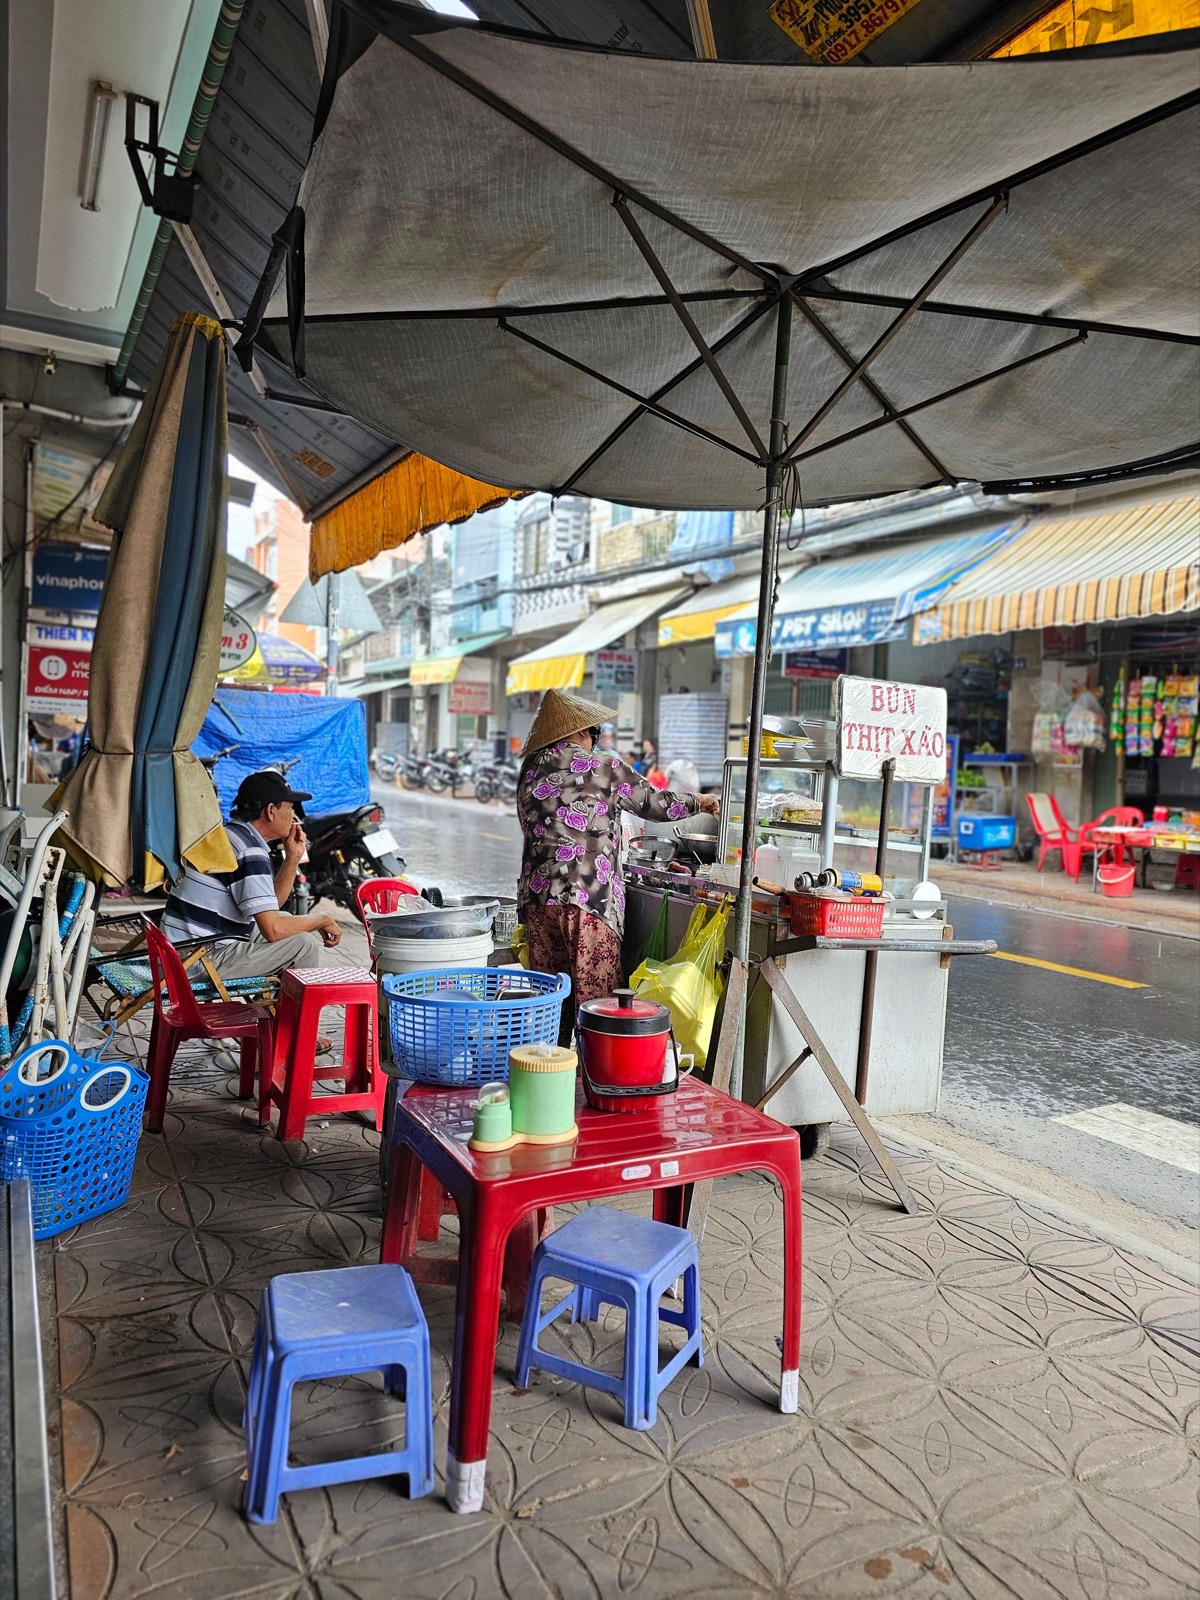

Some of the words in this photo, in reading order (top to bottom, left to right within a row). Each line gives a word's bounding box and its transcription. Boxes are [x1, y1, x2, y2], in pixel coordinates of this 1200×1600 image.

[826, 0, 907, 63] 0917.8679
[236, 632, 249, 650] 3
[871, 684, 916, 715] BÚN
[843, 722, 895, 759] THỊT
